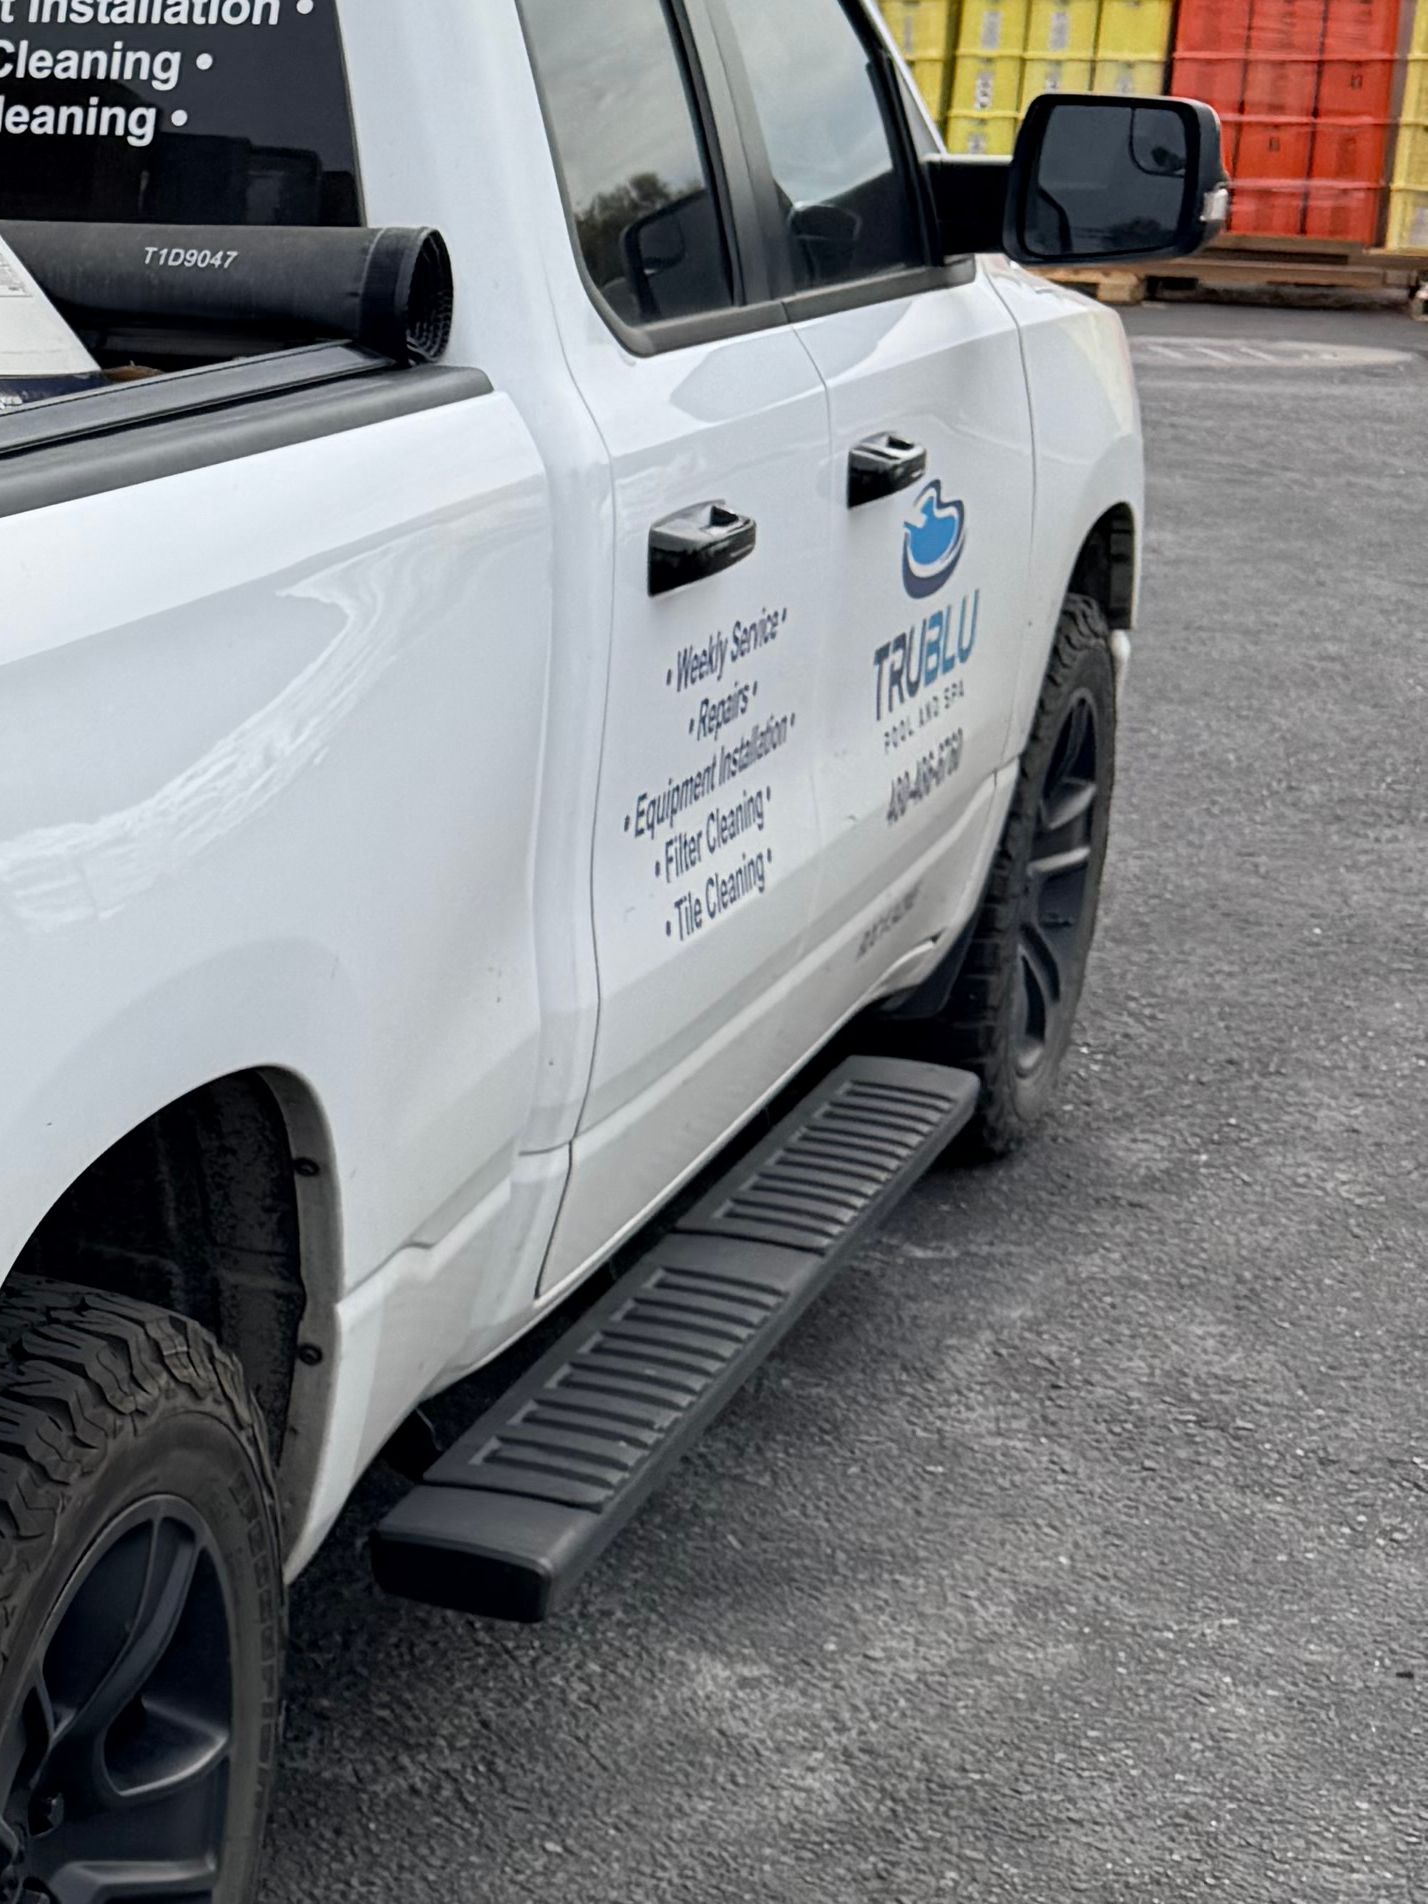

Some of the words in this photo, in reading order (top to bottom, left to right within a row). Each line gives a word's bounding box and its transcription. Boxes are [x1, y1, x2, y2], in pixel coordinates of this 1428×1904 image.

[144, 247, 239, 269] T1D9047
[676, 631, 728, 693] Weekly
[730, 608, 779, 663] Service
[872, 589, 979, 722] TRUBLU
[696, 681, 751, 742] Repairs
[635, 761, 717, 839] Equipment
[719, 716, 789, 782] Installation
[665, 831, 702, 883] Filter
[706, 796, 765, 853] Cleaning
[674, 890, 703, 941] Tile
[705, 854, 766, 916] Cleaning
